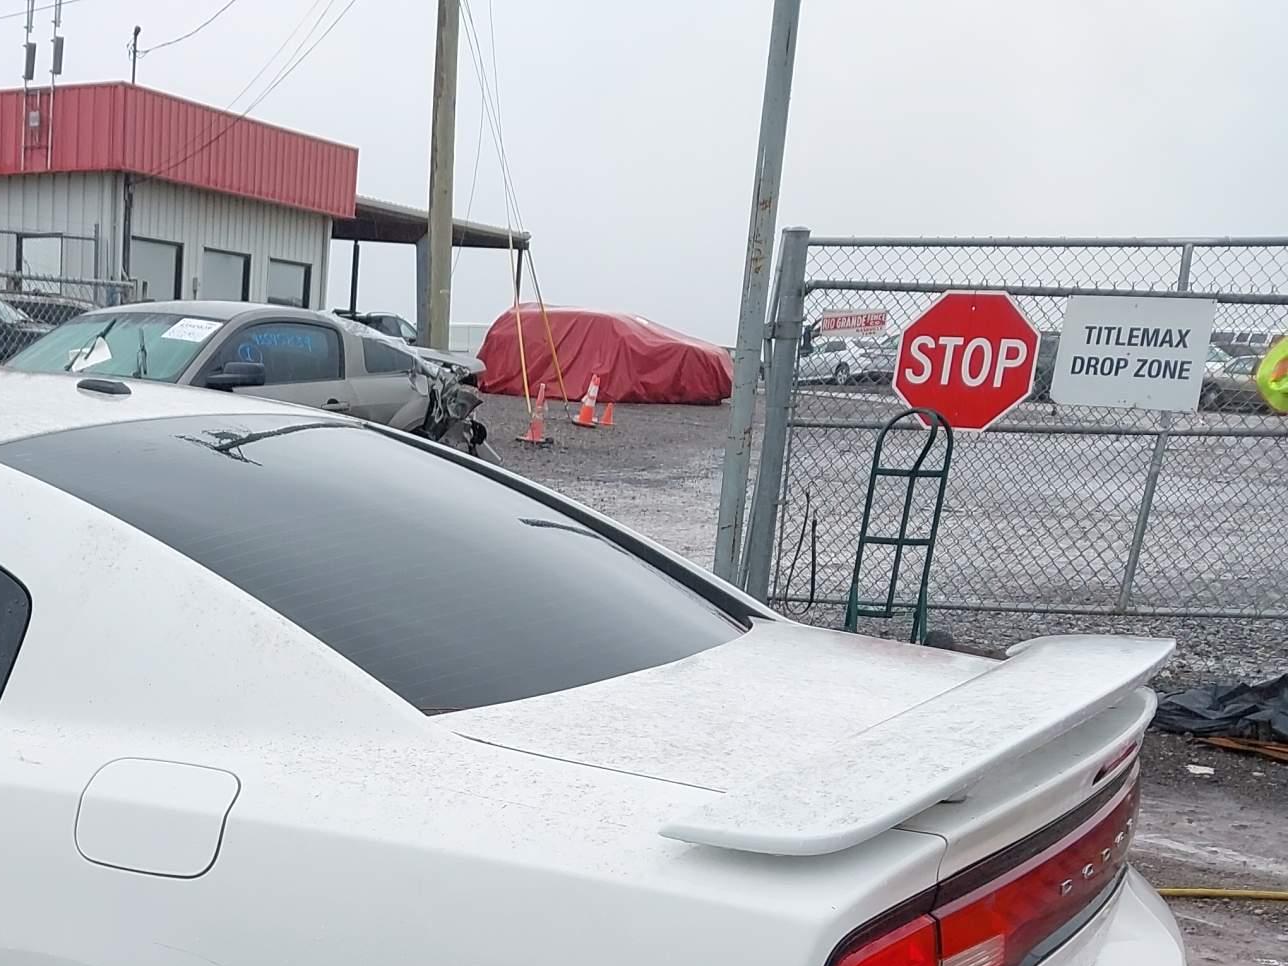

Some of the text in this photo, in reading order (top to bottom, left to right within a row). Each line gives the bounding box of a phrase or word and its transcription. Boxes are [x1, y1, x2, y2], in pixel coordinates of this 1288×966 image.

[823, 317, 836, 330] RIO
[836, 314, 866, 329] GRANDE
[1084, 325, 1192, 349] TITLEMAX
[904, 335, 1028, 388] STOP
[1070, 355, 1193, 380] DROP ZONE
